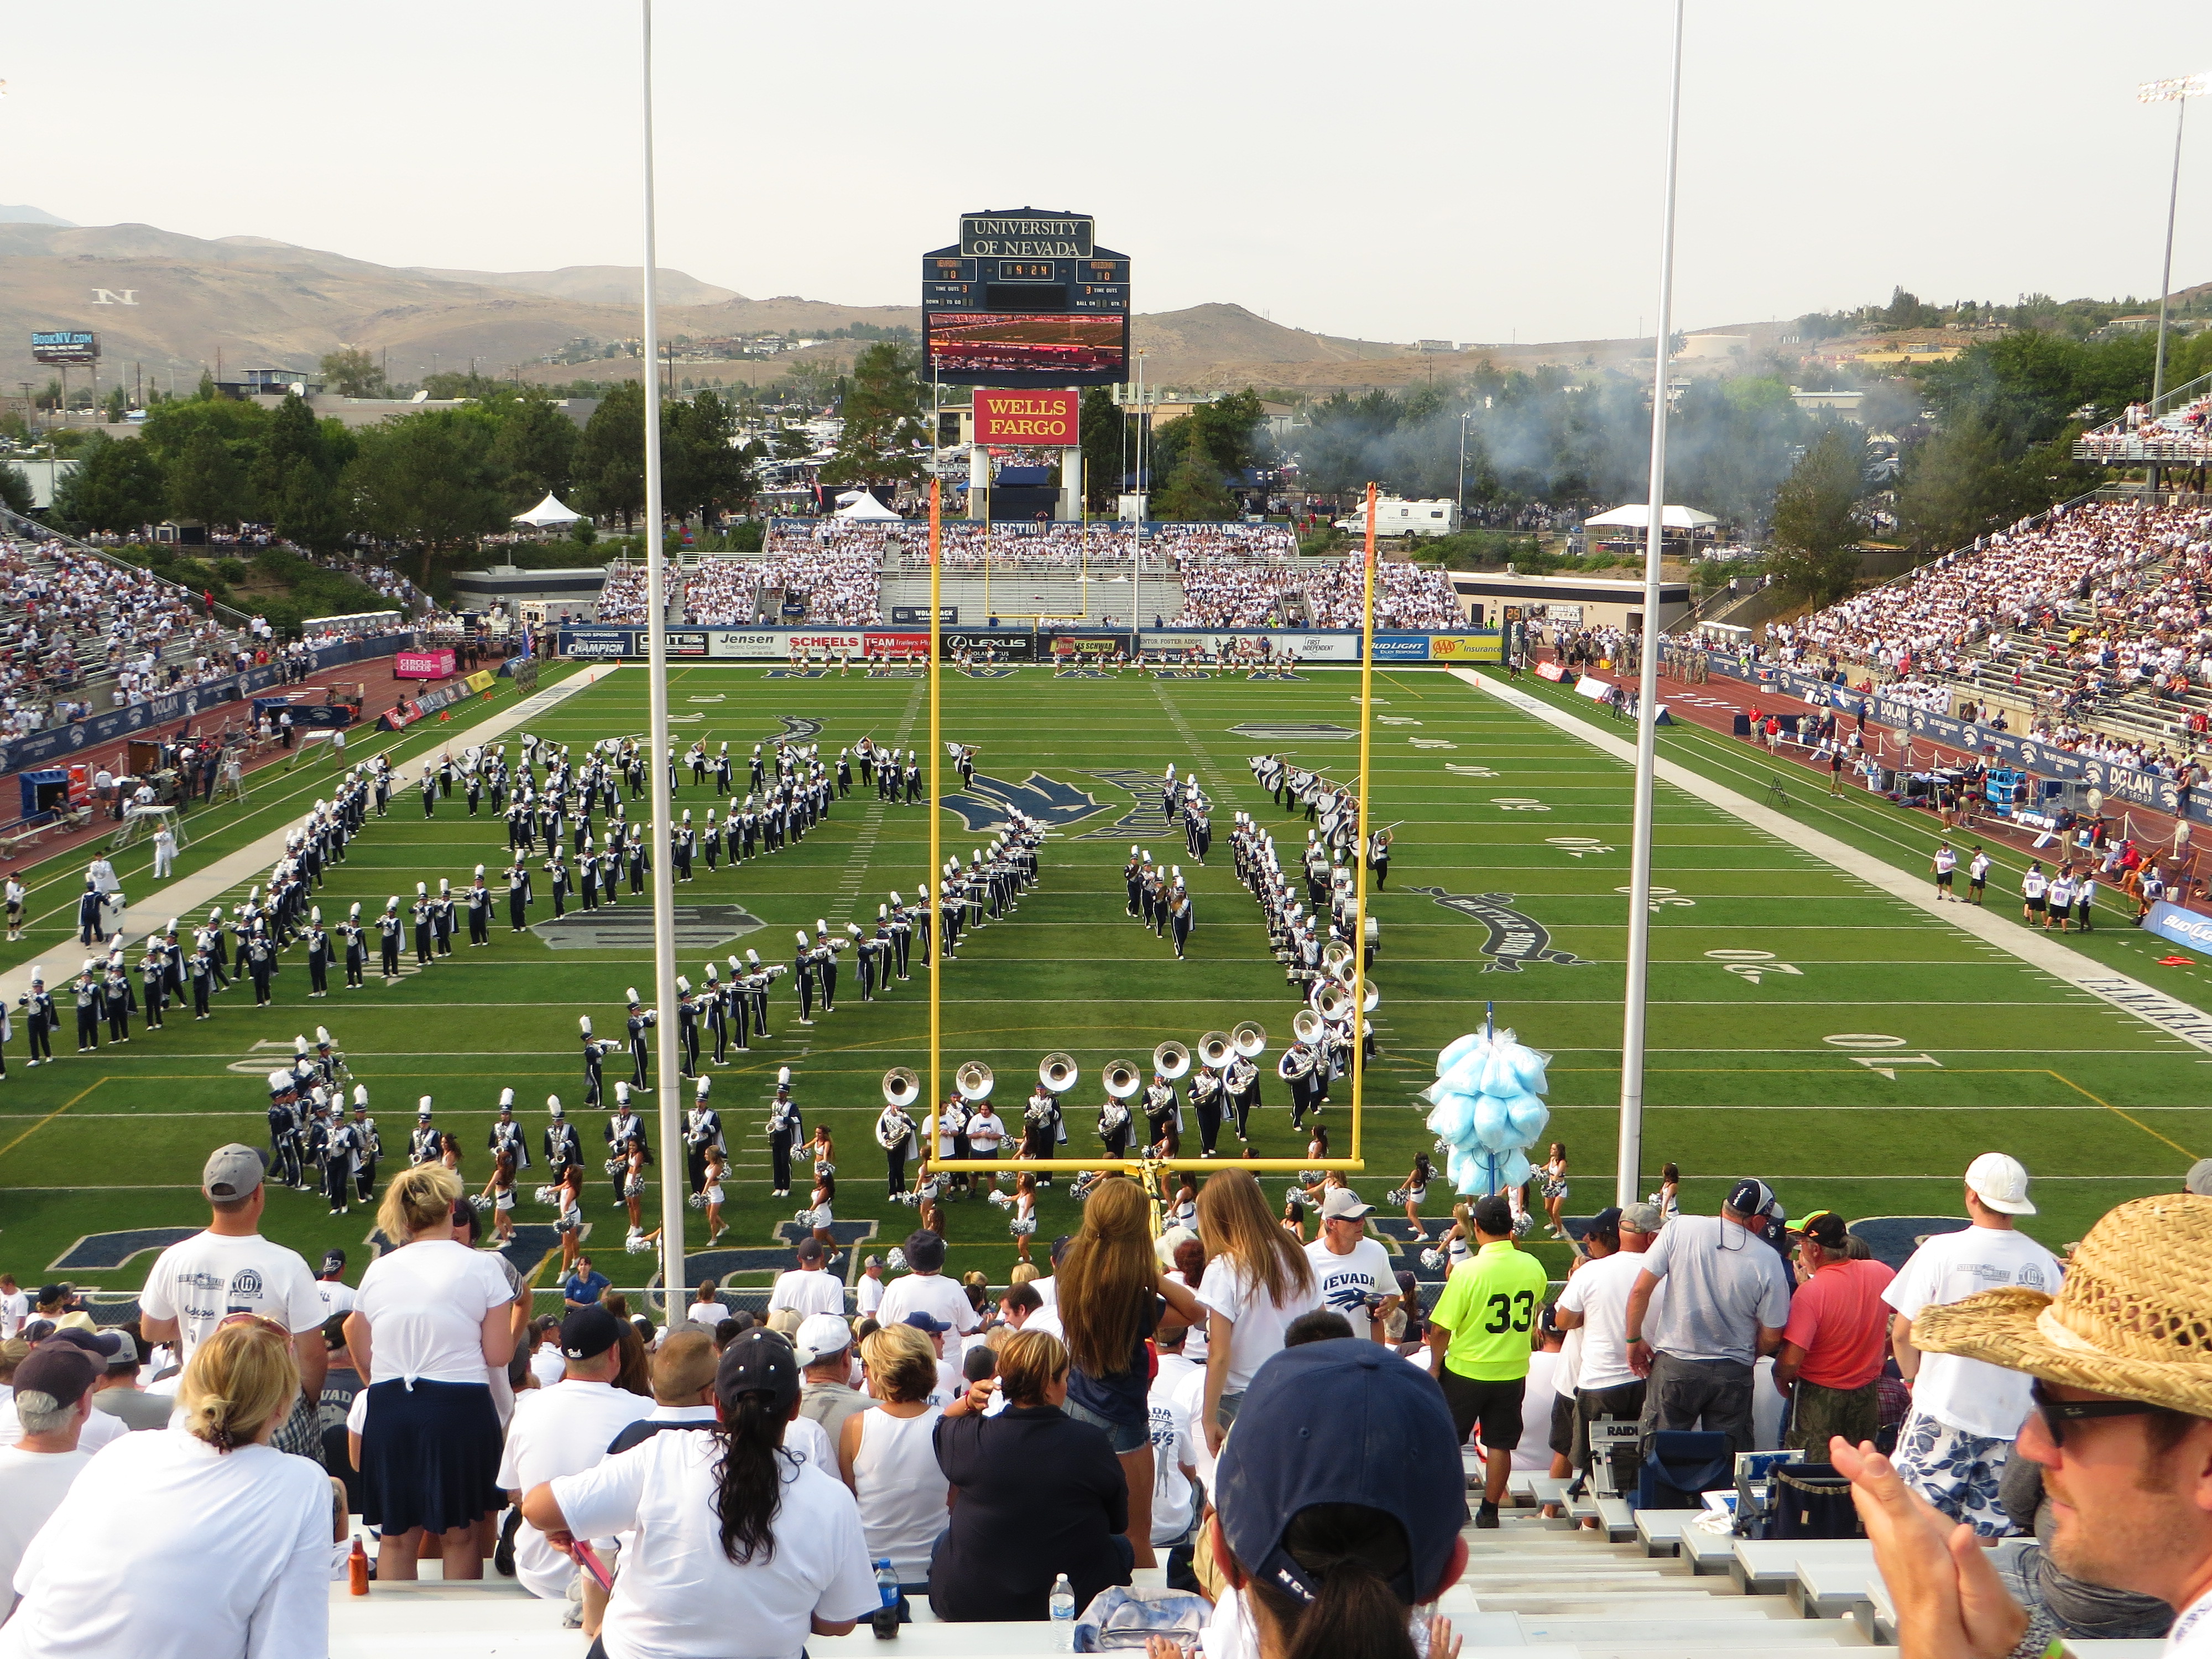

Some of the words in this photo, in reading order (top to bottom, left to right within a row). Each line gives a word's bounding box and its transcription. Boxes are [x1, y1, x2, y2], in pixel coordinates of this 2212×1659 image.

[974, 221, 1078, 236] UNIVERSITY
[973, 241, 999, 255] OF
[1004, 241, 1080, 257] NEVADA
[951, 270, 956, 279] 0
[1104, 272, 1110, 280] 0
[92, 288, 139, 305] N
[988, 400, 1066, 415] WELLS
[989, 420, 1066, 436] FARGO
[992, 524, 1038, 534] SECTIO
[1507, 608, 1520, 619] 25
[720, 634, 774, 644] Jensen
[790, 637, 859, 646] SCHEELS
[969, 639, 1026, 647] LEXUS
[1058, 640, 1073, 649] Tires
[567, 644, 625, 654] CHAMPION
[1434, 641, 1454, 652] AAA
[151, 696, 179, 717] DOLAN
[1880, 700, 1908, 722] DOLAN
[2110, 766, 2153, 795] DOLAN
[1446, 899, 1530, 929] BATTLE
[1494, 931, 1537, 956] BORN
[2162, 915, 2192, 932] BUD
[1348, 1192, 1361, 1203] N
[1485, 1290, 1535, 1334] 33
